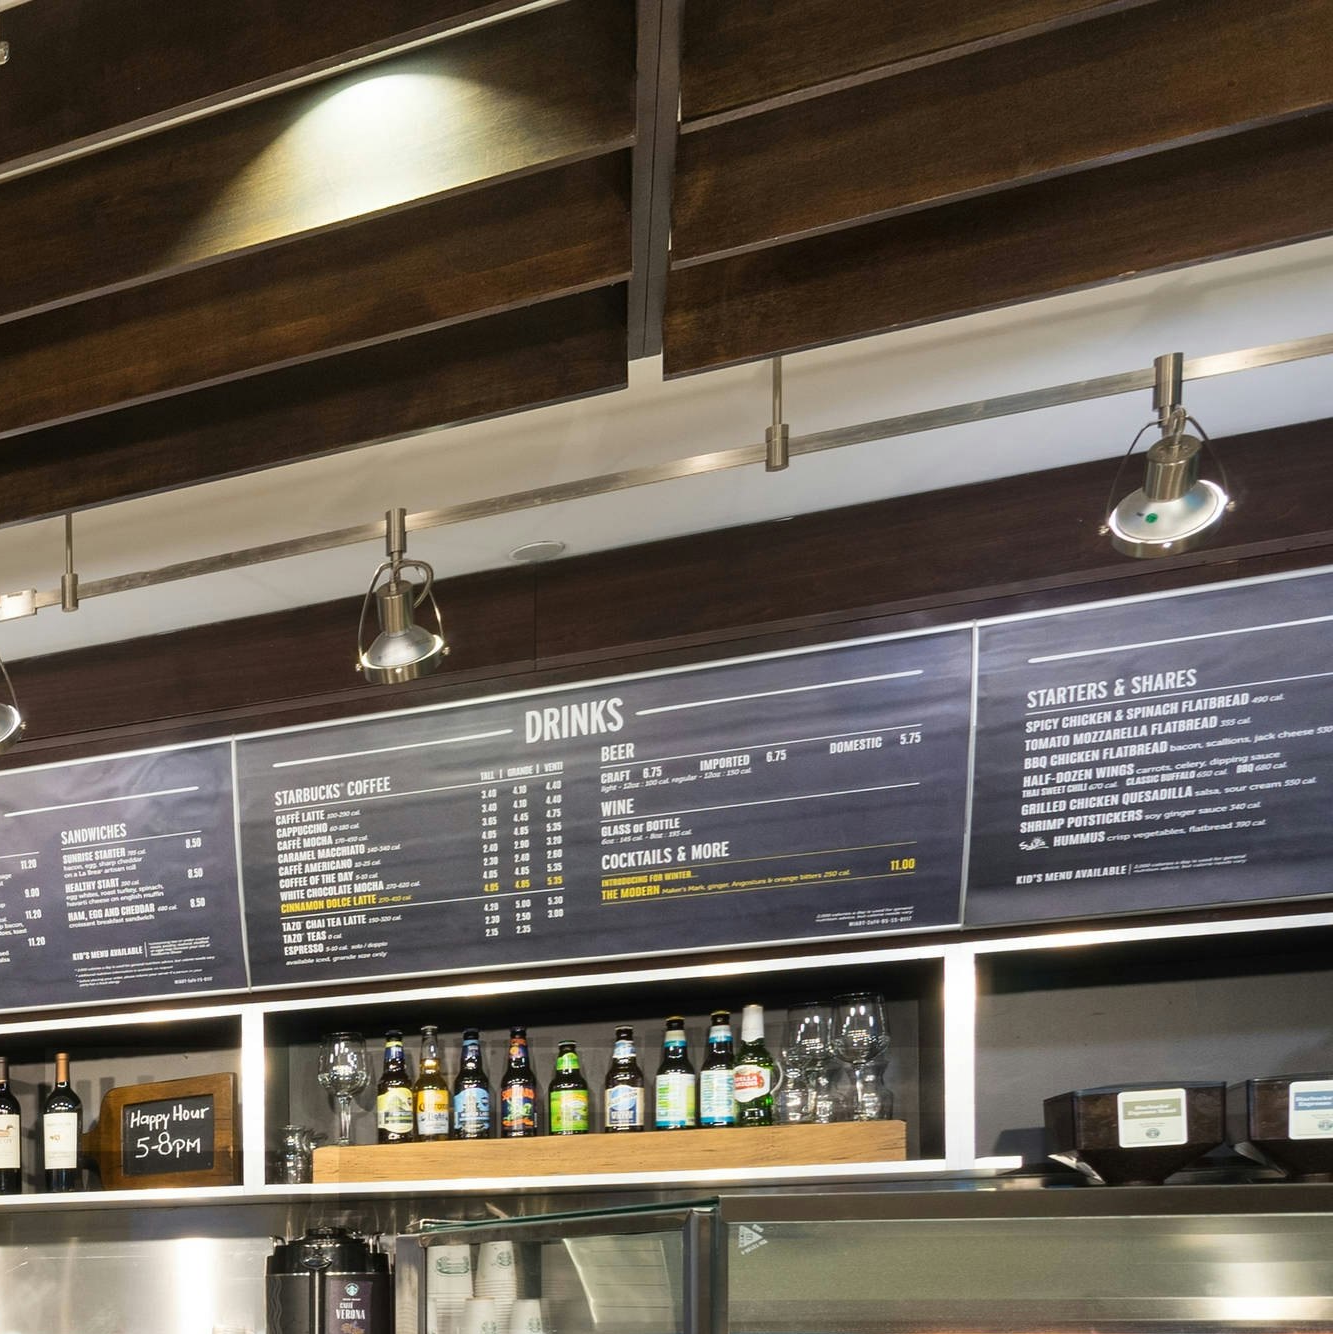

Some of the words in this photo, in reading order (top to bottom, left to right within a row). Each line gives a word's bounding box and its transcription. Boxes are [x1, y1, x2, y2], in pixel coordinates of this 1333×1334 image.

[1027, 681, 1108, 708] STARTERS
[1114, 679, 1125, 696] &
[1131, 668, 1197, 694] SHARES
[525, 698, 624, 744] DRINKS
[1026, 718, 1059, 733] SPICY
[1061, 711, 1112, 728] CHICKEN
[1115, 710, 1123, 721] &
[1126, 702, 1178, 720] SPINACH
[1182, 693, 1250, 713] FLATBREAD
[1025, 735, 1070, 751] TOMATO
[1073, 725, 1147, 746] MOZZARELLA
[1151, 716, 1218, 736] FLATBREAD
[601, 743, 635, 762] BEER
[601, 770, 630, 784] CRAFT
[643, 766, 662, 778] 6.75
[700, 755, 750, 771] IMPORTED
[766, 750, 786, 762] 6.75
[830, 737, 882, 754] DOMESTIC
[900, 732, 921, 745] 5.75
[1024, 756, 1047, 770] BBQ
[1050, 750, 1099, 766] CHICKEN
[1103, 741, 1168, 759] FLATBREAD
[1253, 734, 1275, 744] jack
[1277, 729, 1314, 738] cheese
[481, 770, 495, 780] TALL
[507, 766, 533, 777] GRANDE
[544, 761, 563, 772] VENTI
[1023, 768, 1092, 787] HALF-DOZEN
[1096, 764, 1135, 779] WINGS
[1209, 755, 1248, 766] dipping
[1251, 752, 1281, 760] sauce
[1126, 774, 1159, 786] CLASSIC
[1161, 771, 1195, 782] BUFFALO
[347, 777, 391, 796] COFFEE
[1022, 789, 1040, 798] THAI
[1041, 786, 1065, 796] SWEET
[1067, 783, 1087, 793] CHILI
[601, 799, 634, 817] WINE
[1021, 800, 1066, 816] GRILLED
[1069, 794, 1119, 810] CHICKEN
[1122, 786, 1192, 806] QUESADILLA
[1249, 781, 1282, 790] cream
[302, 810, 325, 822] LATTE
[1020, 818, 1065, 833] SHRIMP
[1067, 810, 1143, 828] POTSTICKERS
[1164, 809, 1196, 820] ginger
[1198, 806, 1227, 814] sauce
[61, 823, 127, 845] SANDWICHES
[277, 823, 328, 838] CAPPUCCINO
[601, 824, 631, 837] GLASS
[646, 818, 680, 832] BOTTLE
[1053, 831, 1106, 847] HUMMUS
[1189, 822, 1233, 833] flatbread
[303, 835, 333, 847] MOCHA
[63, 851, 93, 864] SUNRISE
[95, 848, 126, 861] STARTER
[278, 850, 316, 864] CARAMEL
[318, 844, 365, 858] MACCHIATO
[601, 848, 672, 870] COCKTAILS
[677, 846, 686, 861] &
[691, 841, 730, 860] MORE
[305, 859, 352, 873] AMERICANO
[1016, 874, 1042, 884] KID'S
[1045, 871, 1073, 881] MENU
[1075, 866, 1127, 879] AVAILABLE
[65, 880, 96, 893] HEALTHY
[97, 878, 119, 889] START
[280, 876, 308, 889] COFFEE
[309, 875, 320, 885] OF
[321, 874, 336, 884] THE
[338, 871, 354, 882] DAY
[601, 890, 618, 900] THE
[621, 885, 660, 898] MODERN
[891, 859, 915, 870] 11.00
[601, 876, 648, 887] INTRODUCING
[649, 874, 663, 882] FOR
[280, 890, 305, 901] WHITE
[307, 884, 352, 898] CHOCOLATE
[354, 881, 384, 893] MOCHA
[89, 910, 103, 919] EGG
[105, 907, 119, 917] AND
[121, 903, 155, 915] CHEDDAR
[281, 901, 324, 913] CINNAMON
[326, 897, 351, 909] DOLCE
[353, 894, 376, 906] LATTE
[305, 918, 325, 929] CHAI
[327, 918, 341, 927] TEA
[343, 915, 367, 925] LATTE
[307, 931, 326, 941] TEAS
[284, 943, 323, 955] ESPRESSO
[131, 1109, 170, 1131] Happy
[173, 1103, 210, 1122] Hour
[136, 1132, 201, 1159] 5-8PM
[336, 1310, 365, 1319] VERONA
